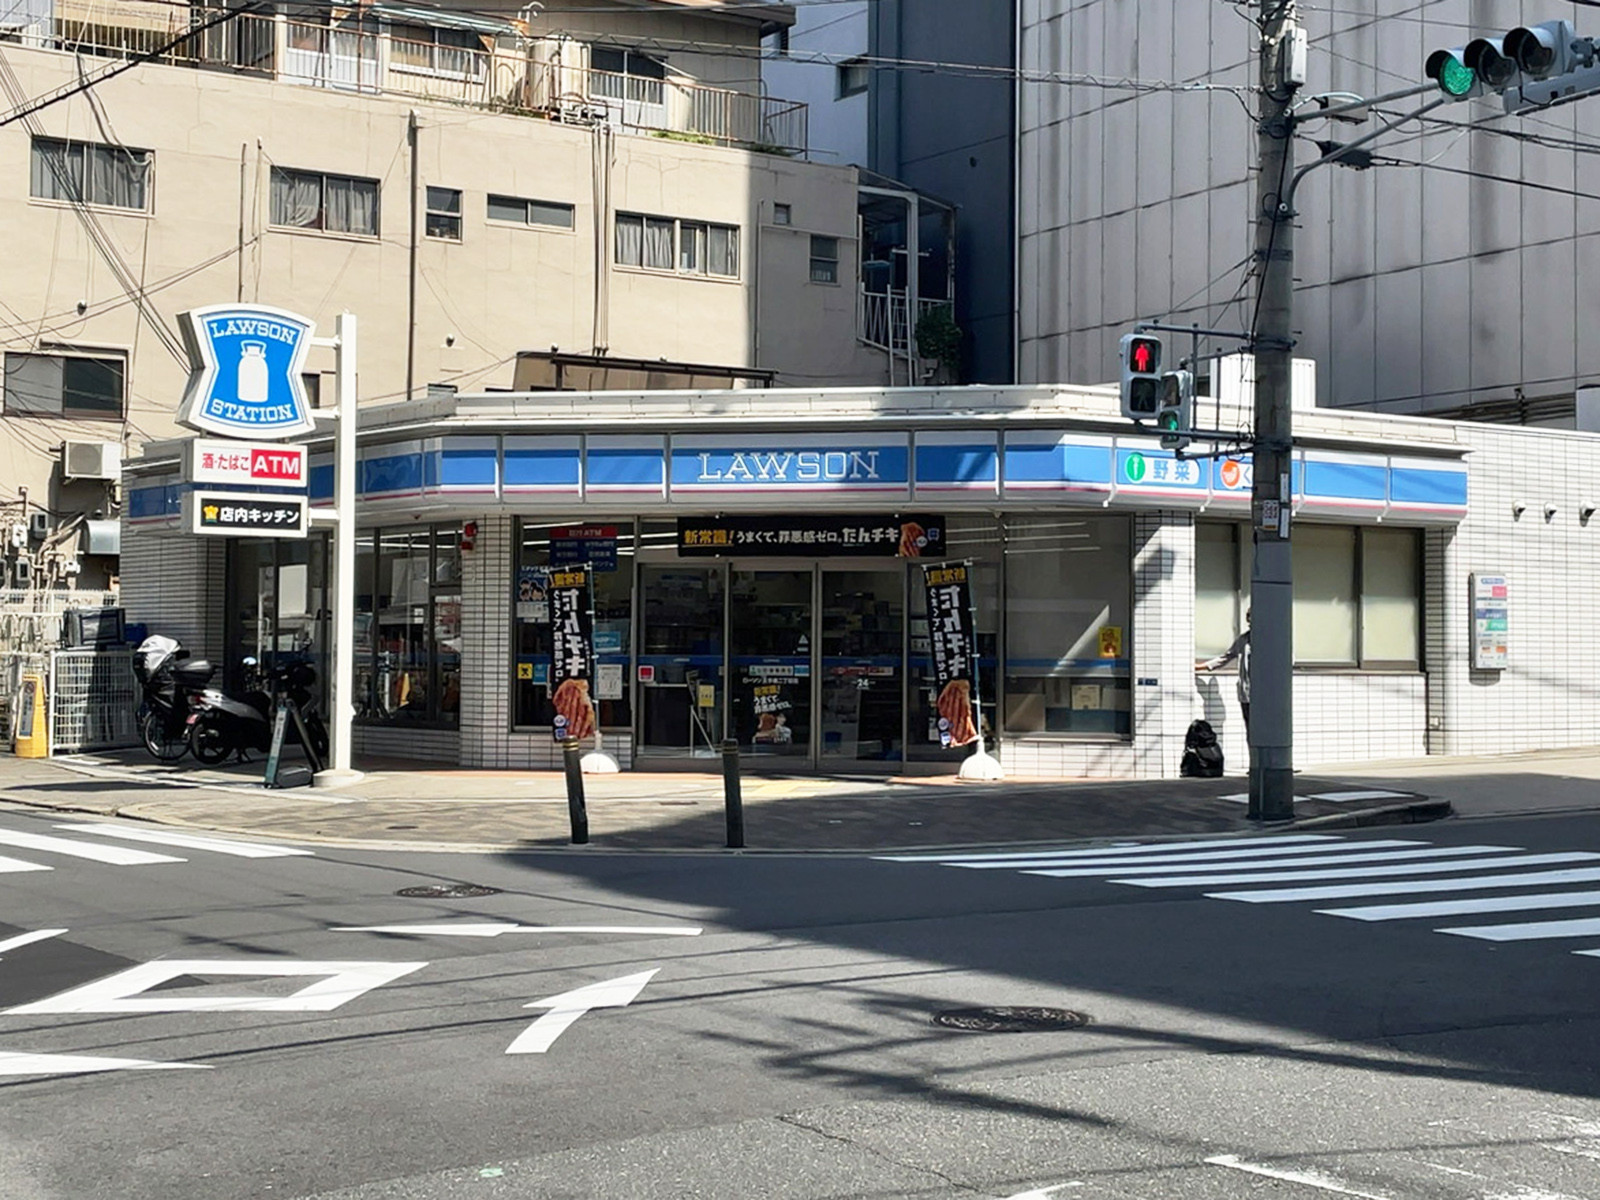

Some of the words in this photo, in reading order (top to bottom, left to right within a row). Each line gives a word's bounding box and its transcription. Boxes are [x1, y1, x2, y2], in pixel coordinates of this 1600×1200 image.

[210, 319, 298, 345] LAWSON
[211, 398, 294, 422] STATION
[253, 455, 299, 475] ATM
[698, 451, 880, 482] LAWSON
[1153, 460, 1190, 482] 野菜
[219, 506, 300, 524] 店内キッチン
[842, 527, 899, 543] たんチキ
